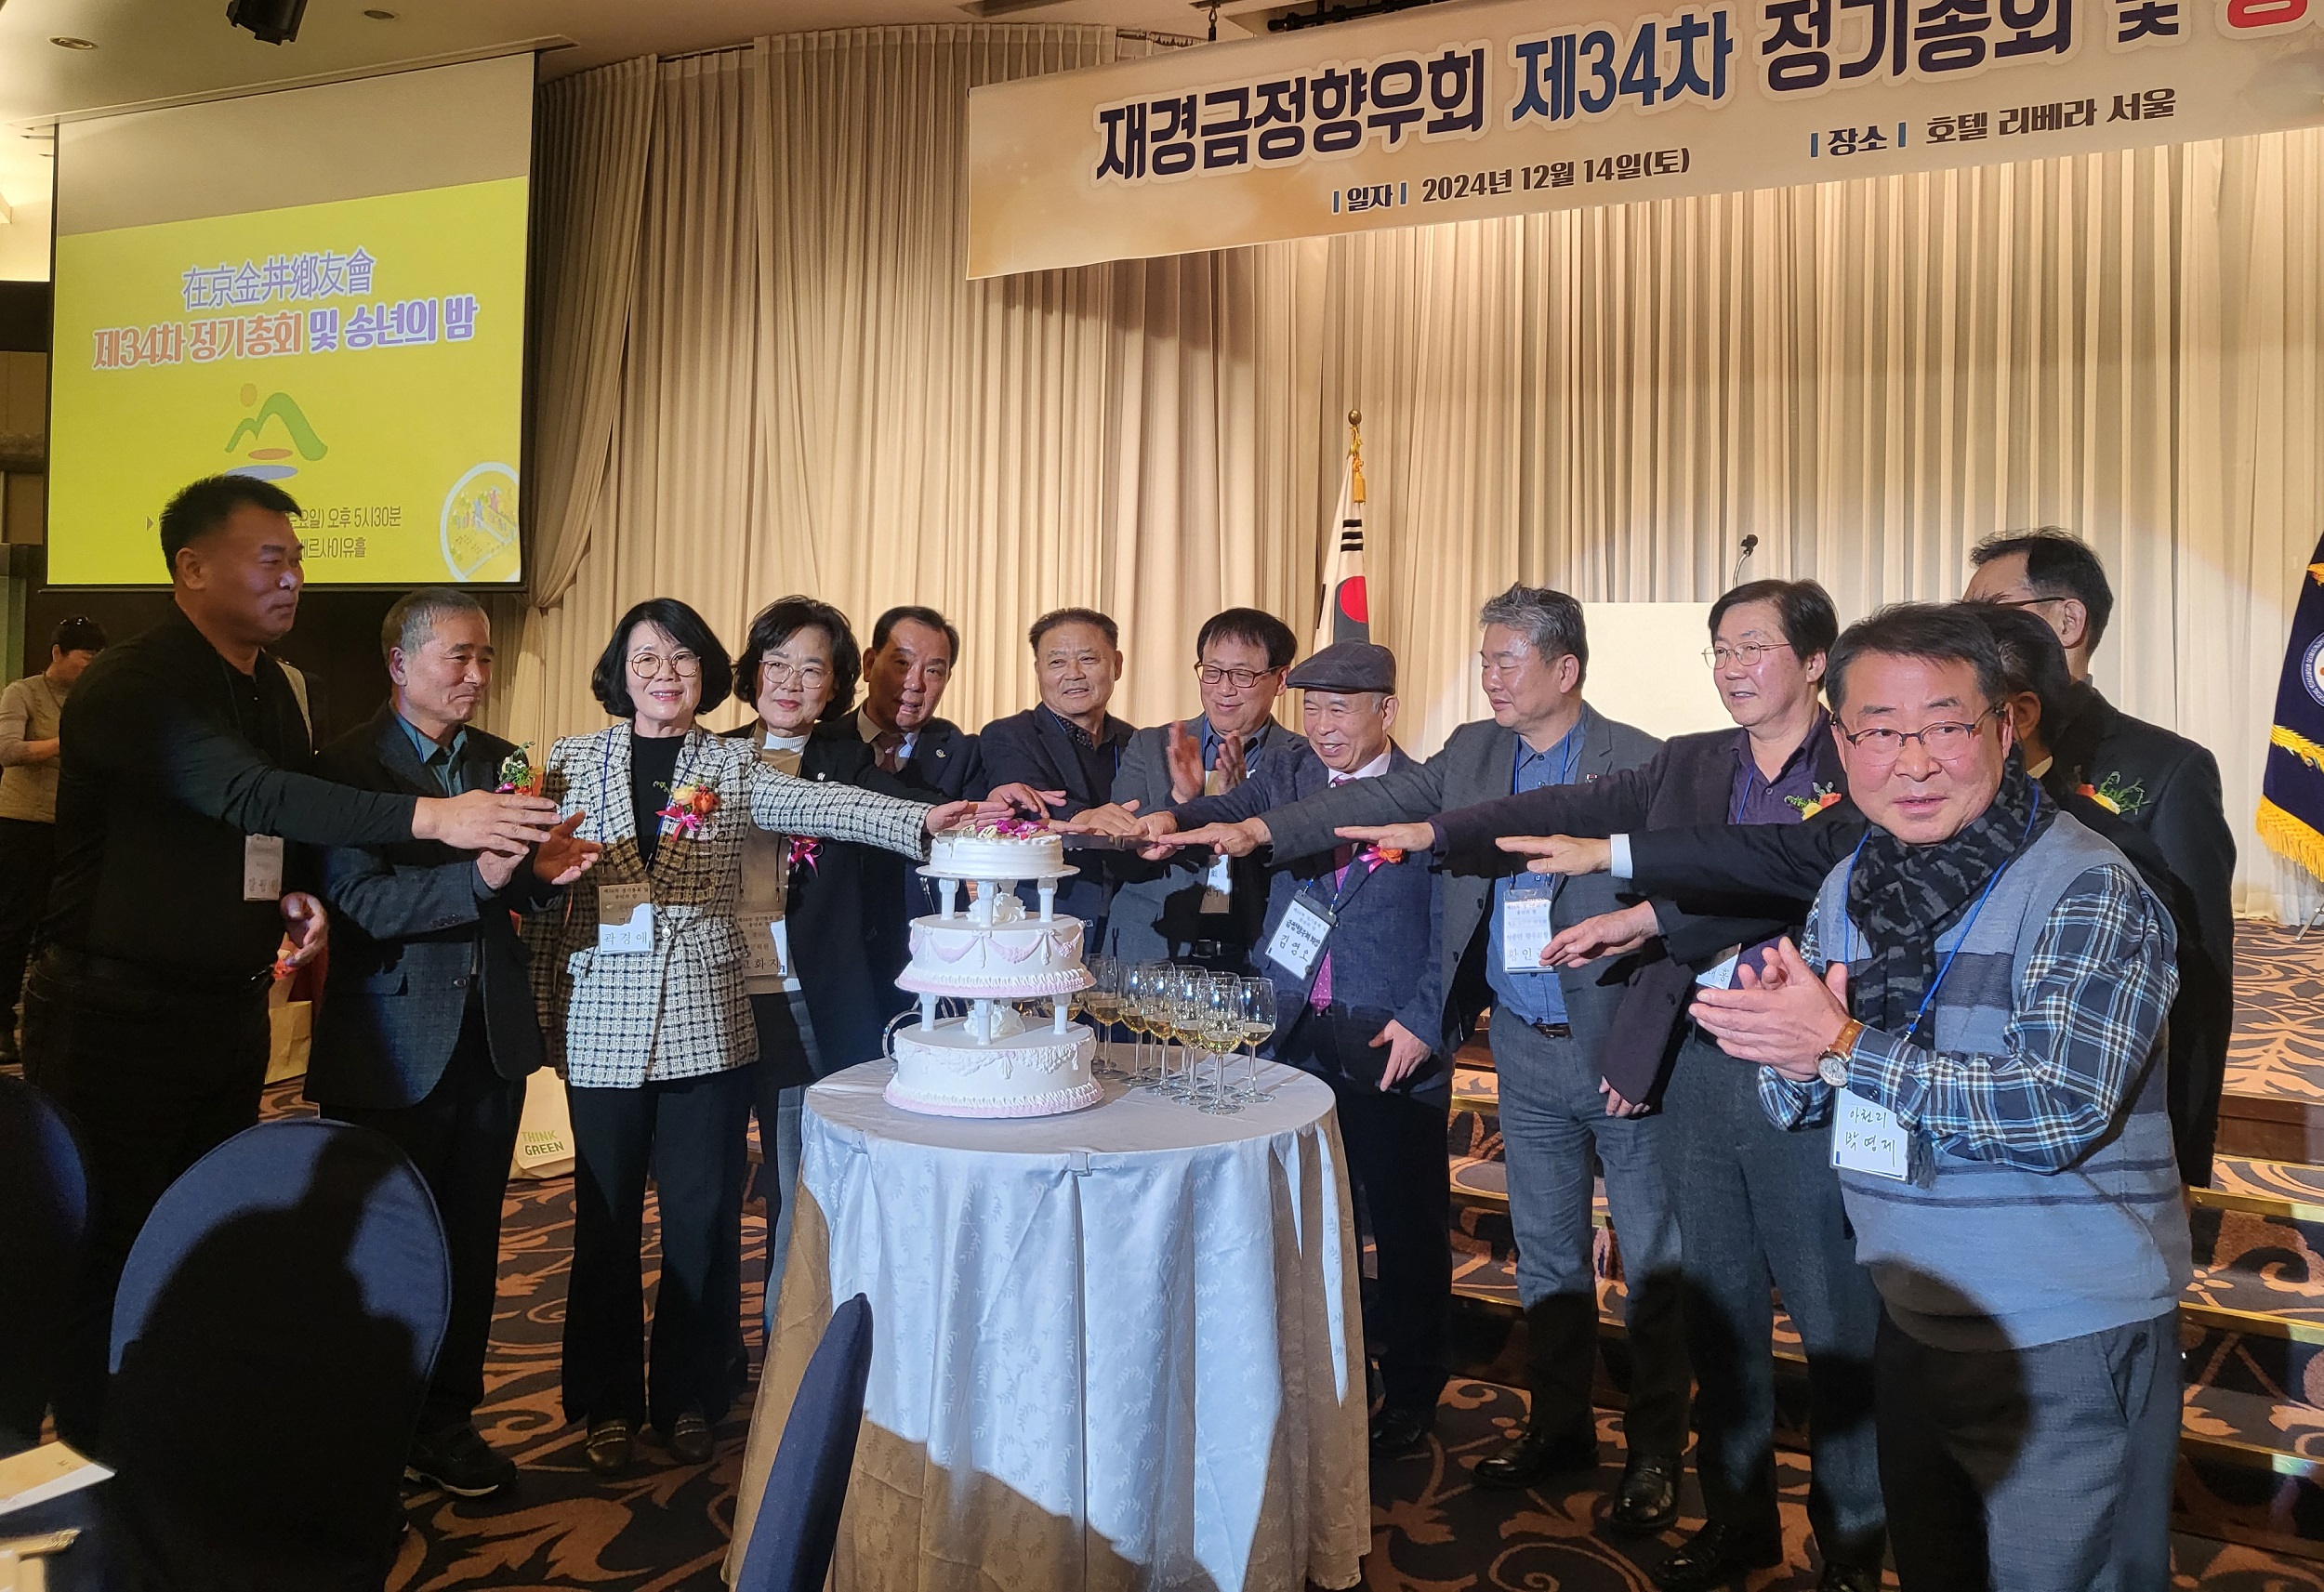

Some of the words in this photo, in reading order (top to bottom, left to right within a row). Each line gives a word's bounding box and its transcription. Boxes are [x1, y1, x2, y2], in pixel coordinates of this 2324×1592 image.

[1096, 48, 1485, 179] 재경금정향우회
[1512, 13, 1733, 122] 제34차
[1828, 125, 1888, 157] 장소
[1926, 112, 1988, 144] 호텔
[1998, 99, 2097, 136] 리베라
[2106, 87, 2177, 124] 서울
[1347, 184, 1393, 212] 일자
[1422, 169, 1512, 204] 2024년
[1521, 161, 1575, 191] 12월
[1583, 147, 1691, 183] 14일(토)
[93, 323, 186, 368] 제34차
[190, 311, 302, 361] 정기총회
[310, 309, 337, 351] 및
[345, 299, 437, 348] 송년의
[445, 296, 478, 340] 밤
[328, 507, 351, 529] 오후
[354, 506, 402, 528] 5시30분
[521, 1130, 558, 1142] THINK
[524, 1141, 565, 1156] GREEN
